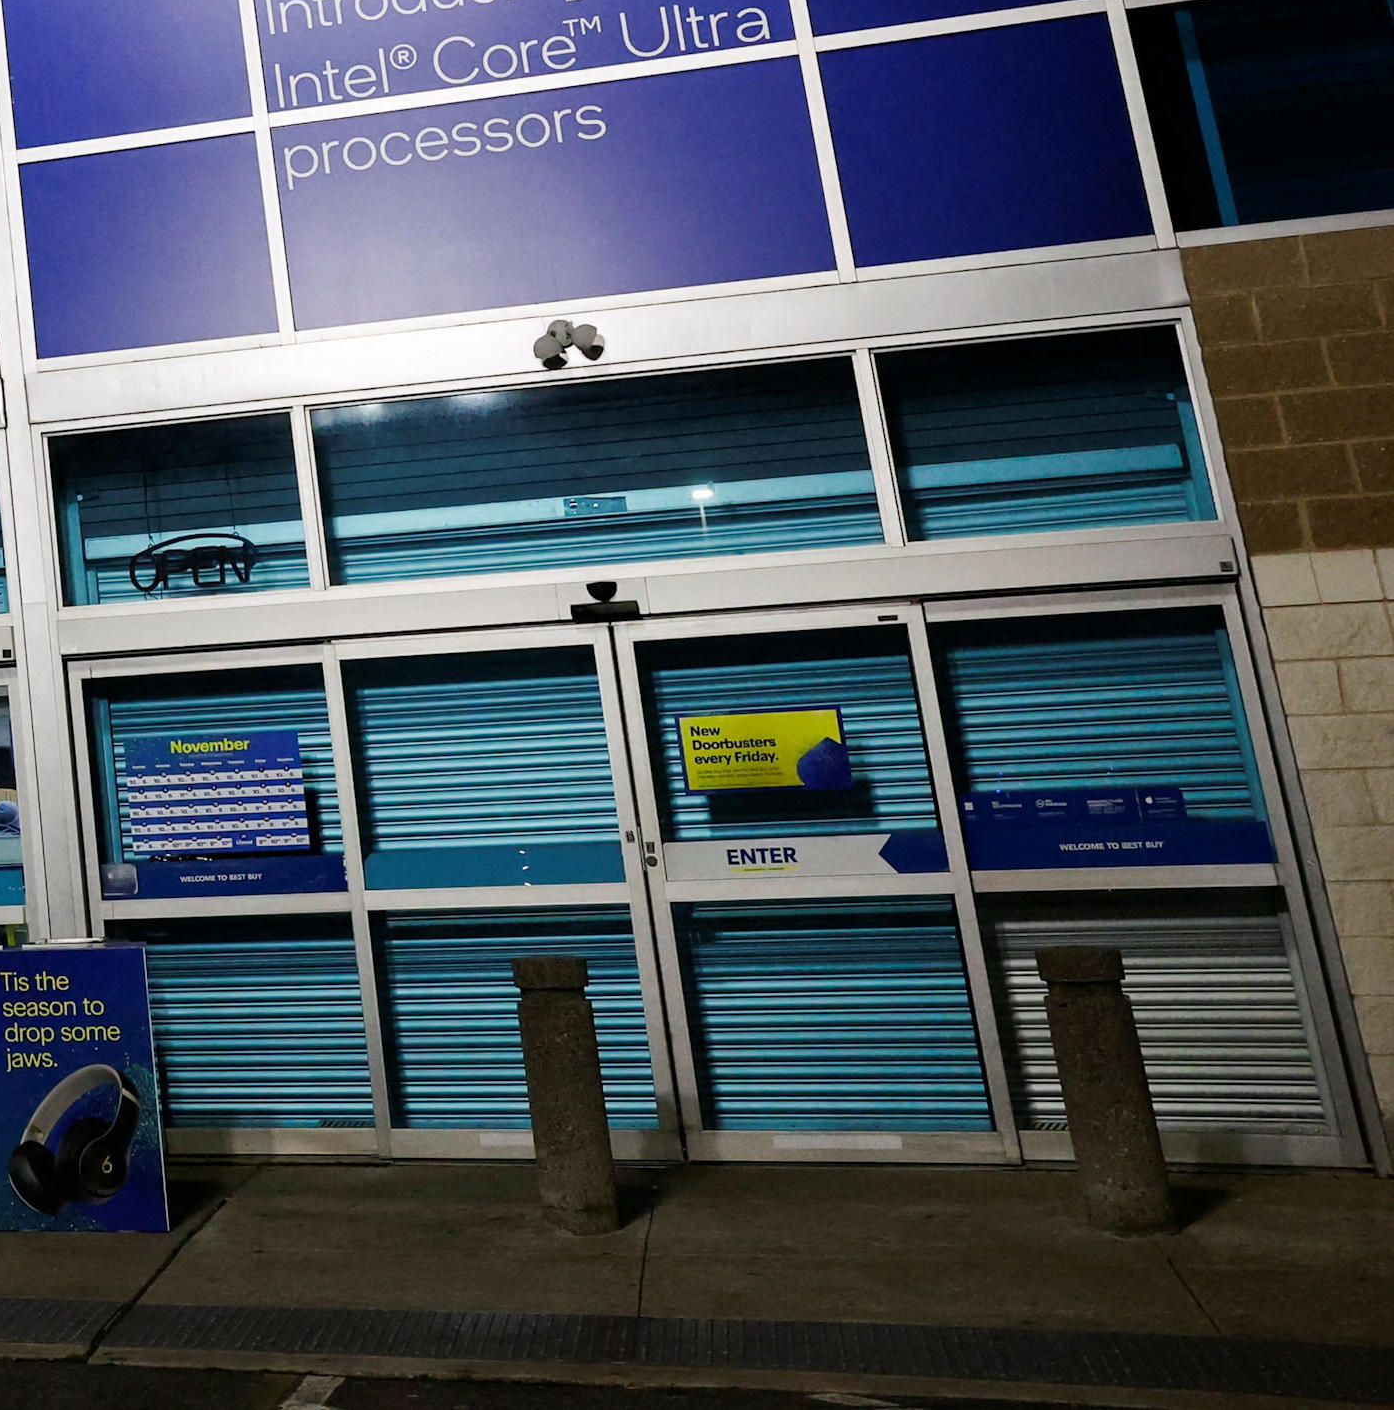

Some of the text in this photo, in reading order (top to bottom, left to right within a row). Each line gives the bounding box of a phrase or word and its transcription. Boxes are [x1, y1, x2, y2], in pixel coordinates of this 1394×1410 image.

[620, 5, 771, 57] Ultra
[283, 105, 608, 190] processors
[690, 726, 721, 737] New
[170, 738, 251, 755] November
[692, 737, 777, 751] Doorbusters
[694, 751, 779, 766] every Friday.
[726, 846, 799, 866] ENTER
[1059, 841, 1164, 852] WELCOME TO BEST BUY
[180, 872, 263, 883] WELCOME TO BEST BUY
[35, 971, 70, 991] the
[2, 998, 105, 1017] season to
[4, 1023, 122, 1046] drop some
[6, 1047, 58, 1072] jaws.
